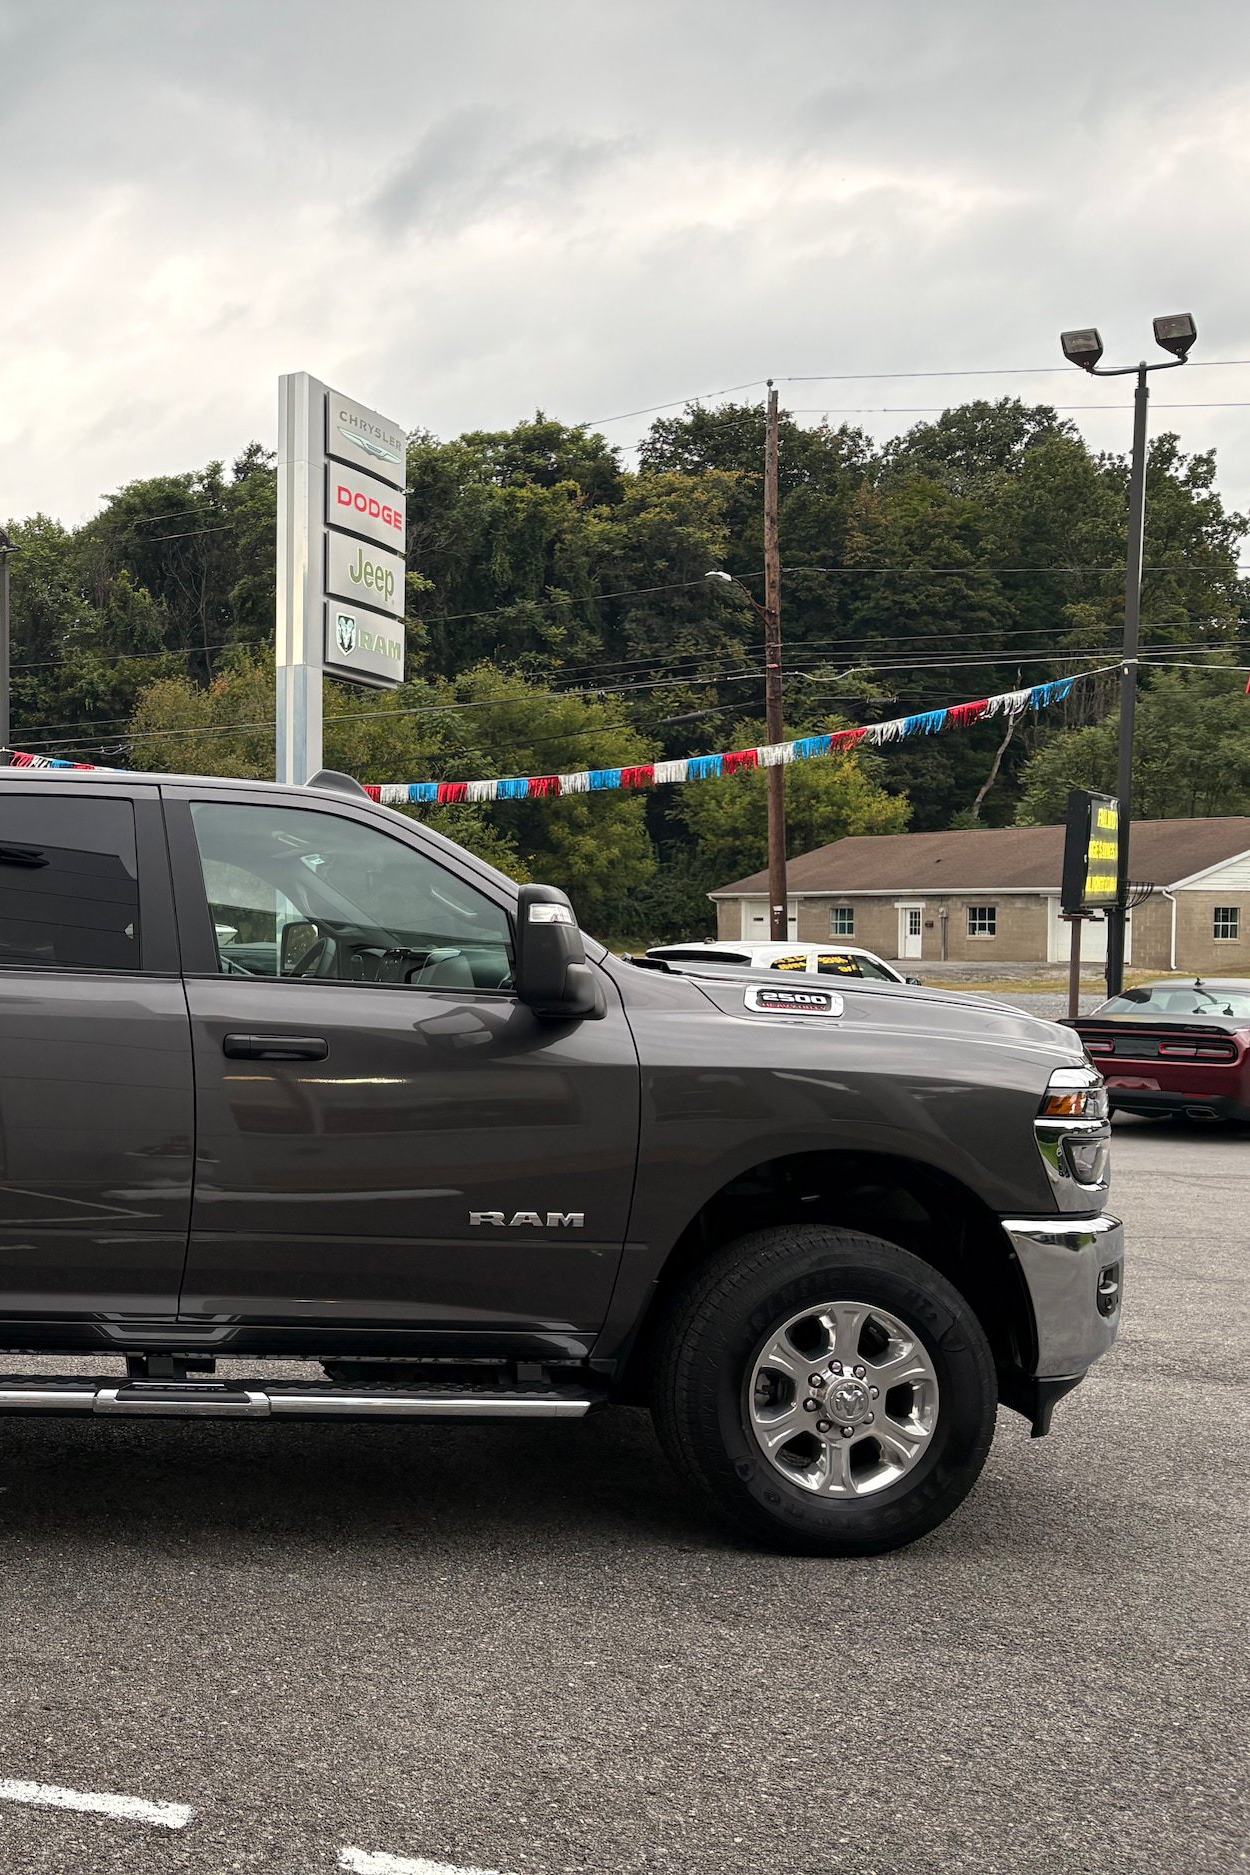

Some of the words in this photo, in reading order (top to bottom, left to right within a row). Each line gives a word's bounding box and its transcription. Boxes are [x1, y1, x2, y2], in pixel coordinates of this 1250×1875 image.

[339, 410, 402, 452] CHRYSLER
[337, 485, 403, 532] DODGE
[349, 547, 394, 602] Jeep
[358, 628, 401, 661] RAM
[761, 992, 827, 1004] 2500
[468, 1210, 585, 1228] RAM
